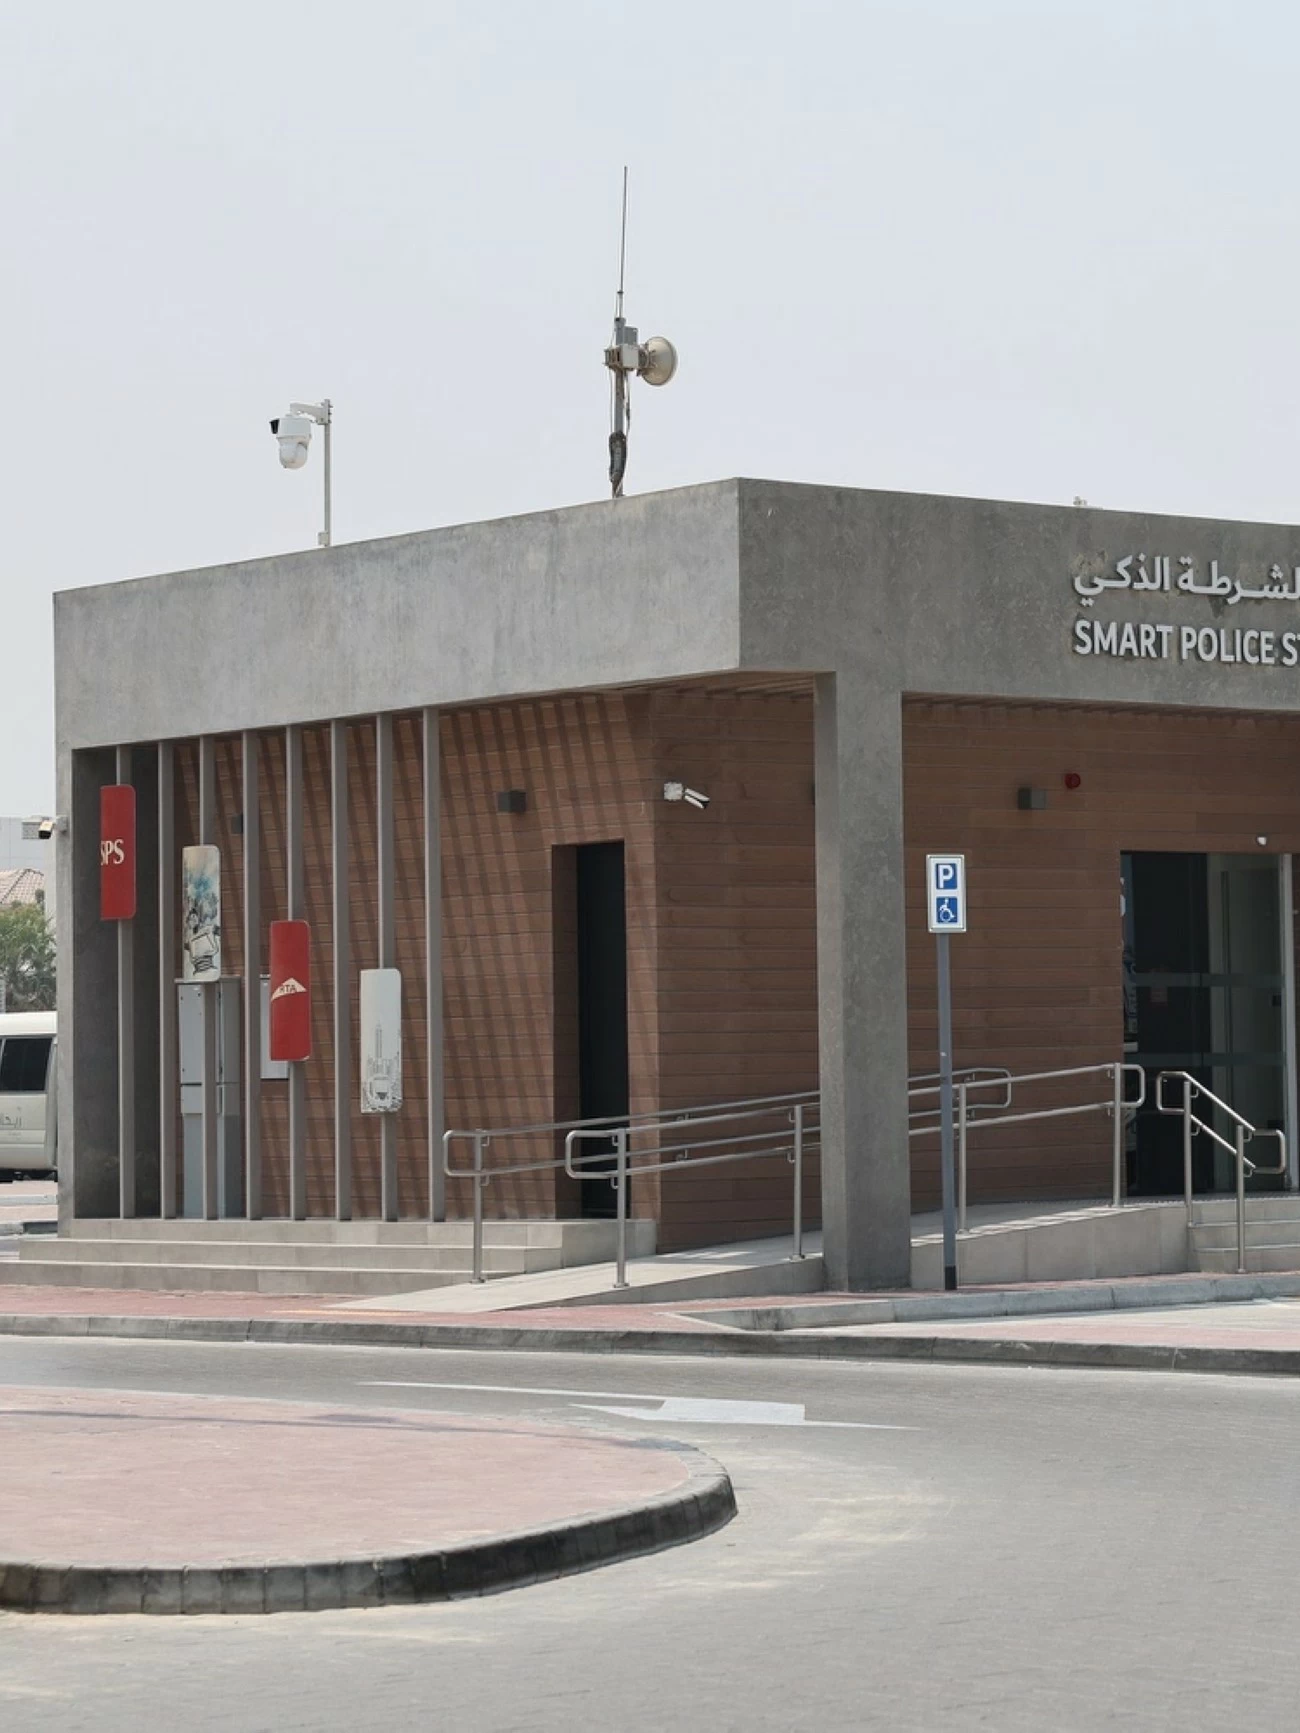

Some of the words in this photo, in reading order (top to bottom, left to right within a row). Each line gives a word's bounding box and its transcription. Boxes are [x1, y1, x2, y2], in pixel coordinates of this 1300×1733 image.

[1074, 553, 1170, 606] الذكي
[1074, 619, 1173, 658] SMART
[1181, 626, 1275, 665] POLICE
[938, 864, 954, 889] P
